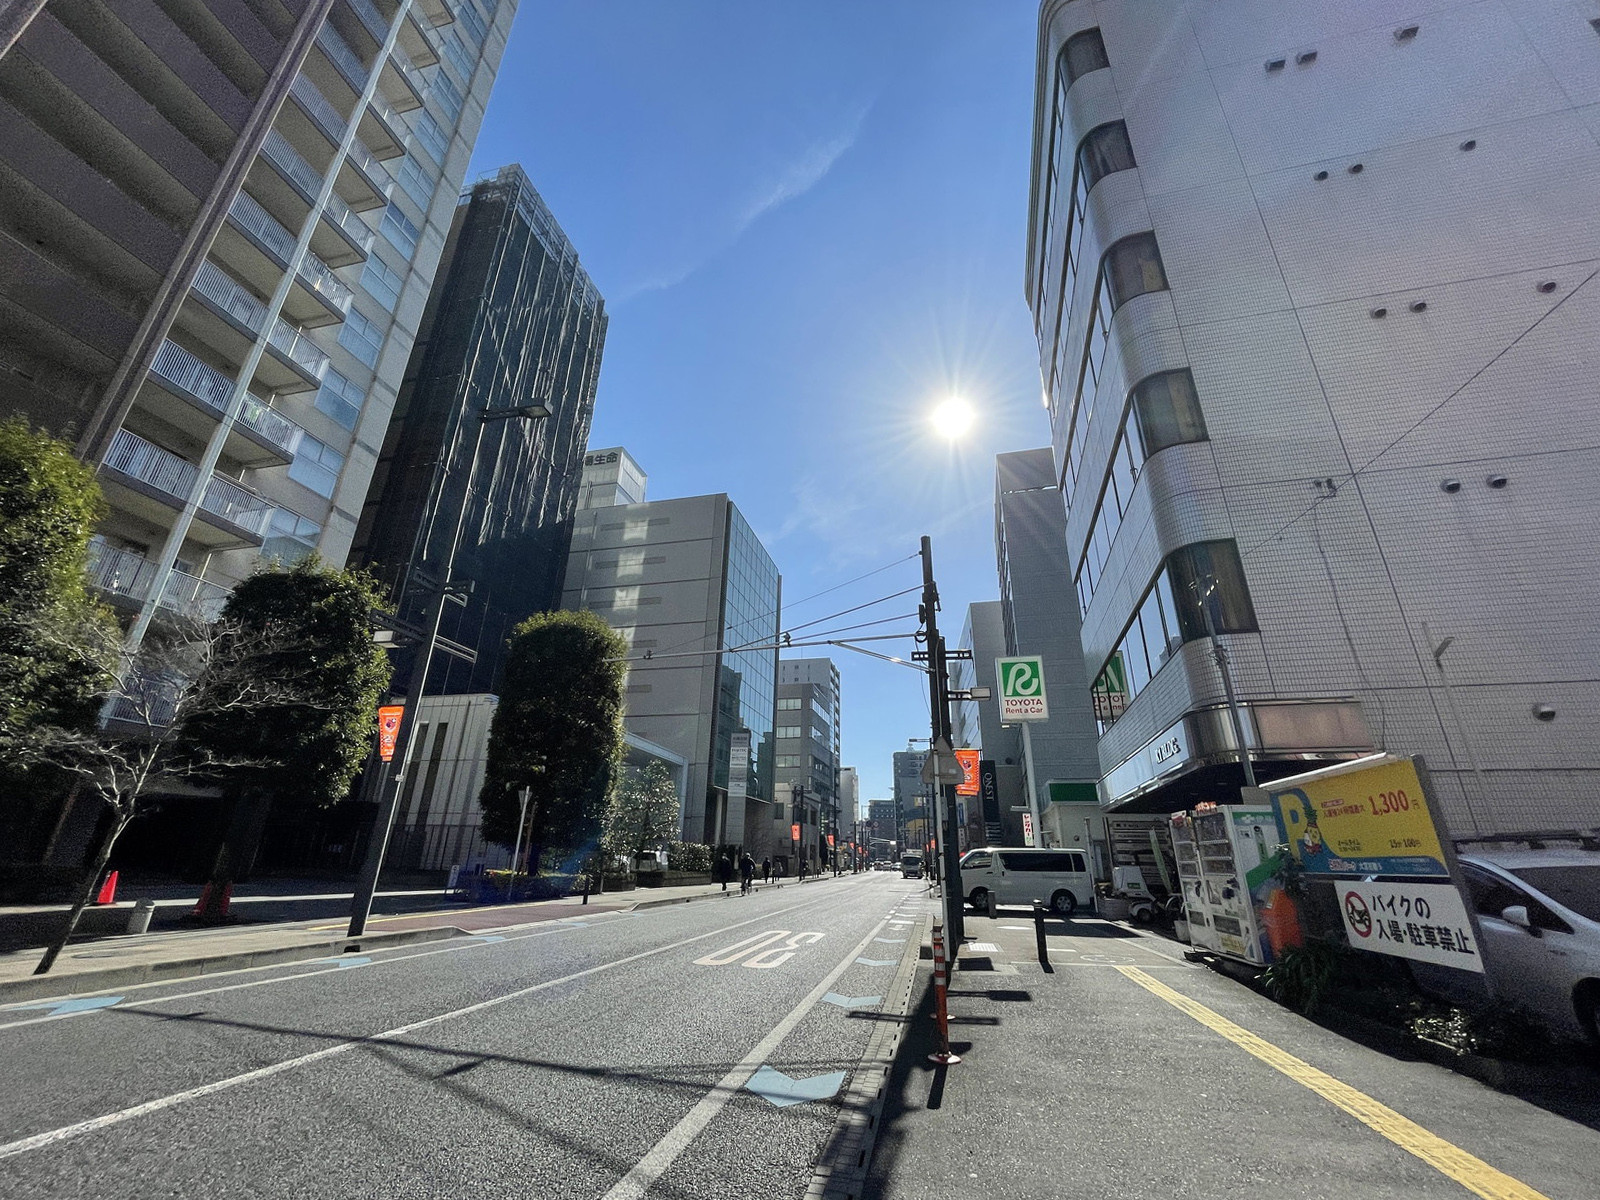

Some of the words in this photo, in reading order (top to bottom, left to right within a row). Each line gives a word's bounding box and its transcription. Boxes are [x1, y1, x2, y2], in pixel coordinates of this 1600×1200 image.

[1372, 894, 1431, 919] バイクの
[1376, 919, 1475, 955] 入場・駐車禁止
